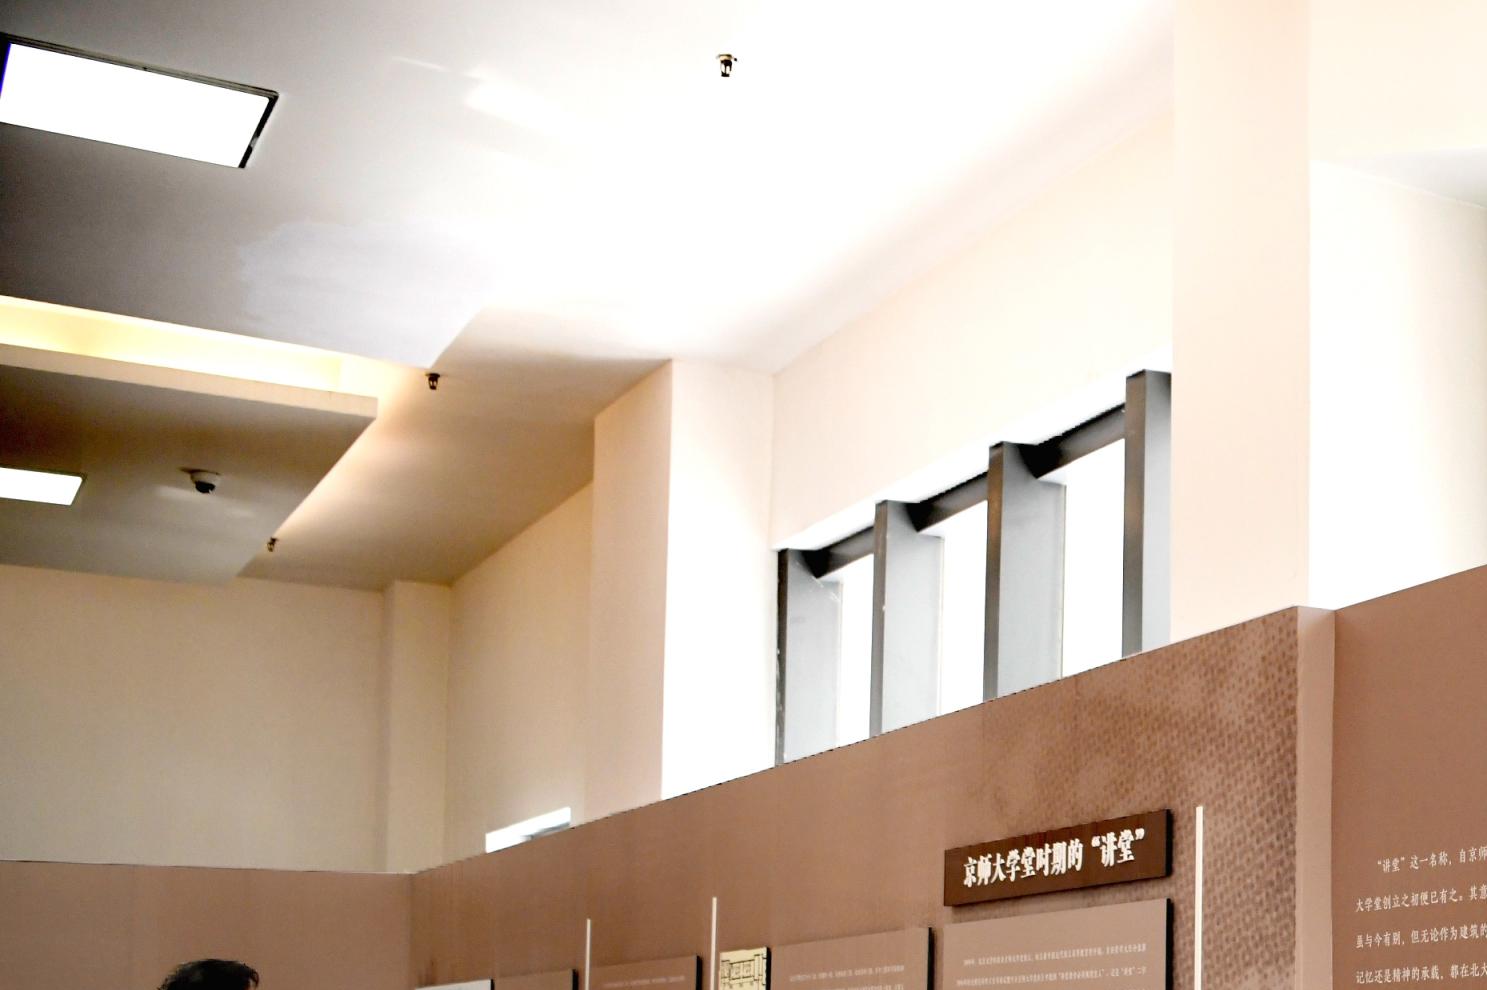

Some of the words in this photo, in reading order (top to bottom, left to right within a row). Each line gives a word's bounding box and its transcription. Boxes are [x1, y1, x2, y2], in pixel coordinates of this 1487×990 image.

[963, 827, 1146, 888] 京师大学堂时期的“讲堂”
